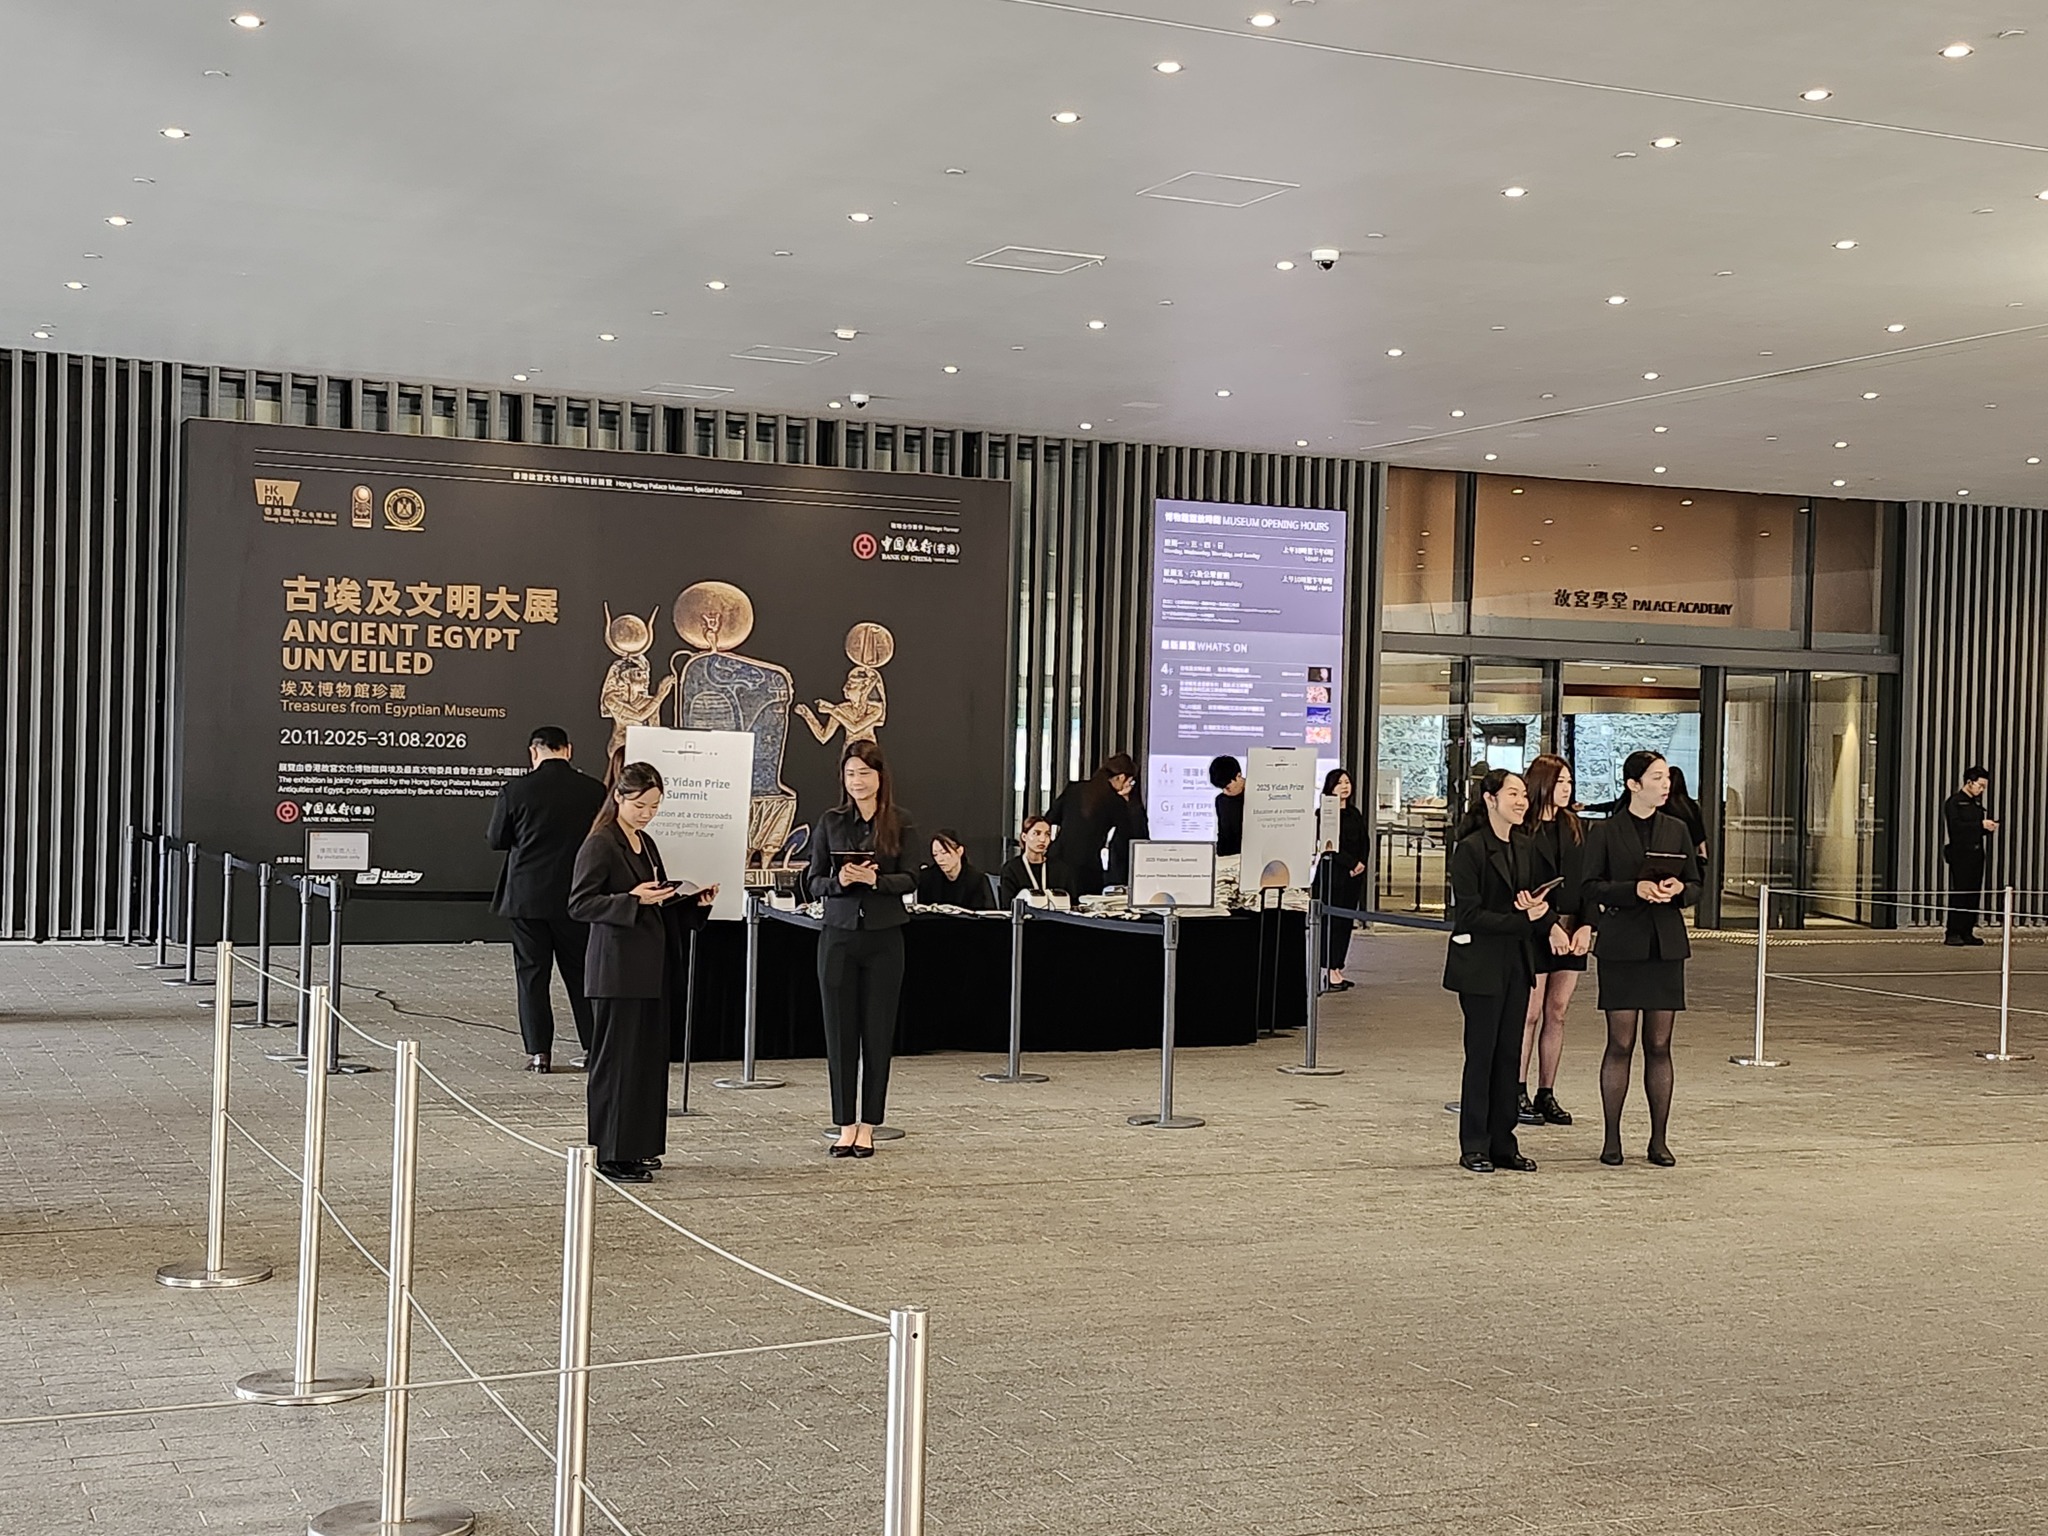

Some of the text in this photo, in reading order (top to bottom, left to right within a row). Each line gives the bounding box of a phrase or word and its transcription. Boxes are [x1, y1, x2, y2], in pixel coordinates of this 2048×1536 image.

[264, 485, 279, 495] HK
[615, 480, 632, 489] Hong
[633, 481, 648, 490] Kong
[649, 482, 667, 491] Palace
[668, 483, 693, 492] Museum
[694, 485, 713, 494] Special
[714, 488, 743, 496] Exhibition
[1222, 516, 1261, 528] MUSEUM
[1261, 518, 1300, 530] OPENING
[1300, 520, 1330, 532] HOURS
[881, 553, 900, 561] BANK
[901, 554, 910, 562] OF
[282, 575, 559, 624] 古埃及文明大展
[1554, 588, 1733, 615] 故宮學堂 PALACE ACADEMY
[282, 619, 521, 650] ANCIENT EGYPT
[1197, 641, 1231, 652] WHAT'S
[1233, 643, 1248, 653] ON
[281, 646, 433, 675] UNVEILED
[280, 680, 406, 700] 埃及博物館珍藏
[280, 699, 506, 718] Treasures from Egyptian Museums
[278, 775, 292, 784] The
[293, 776, 326, 784] exhibition
[327, 776, 333, 784] is
[333, 776, 354, 785] jointly
[355, 778, 388, 786] organised
[389, 778, 398, 787] by
[399, 778, 410, 786] the
[411, 778, 429, 787] Hong
[430, 779, 448, 788] Kong
[449, 779, 471, 787] Palace
[471, 779, 500, 787] Museum
[672, 777, 702, 788] Yidan
[705, 779, 730, 789] Prize
[278, 786, 313, 794] Antiquities
[315, 786, 322, 794] of
[346, 787, 372, 796] proudly
[373, 787, 407, 796] supported
[408, 788, 417, 797] by
[417, 788, 435, 796] Bank
[435, 788, 443, 796] of
[444, 788, 463, 796] China
[464, 789, 484, 798] (Hong
[485, 789, 499, 797] Kon
[1256, 784, 1270, 792] 2025
[666, 790, 708, 801] Summit
[1268, 793, 1292, 801] Summit
[693, 812, 732, 820] crossroads
[382, 870, 423, 880] UnionPay
